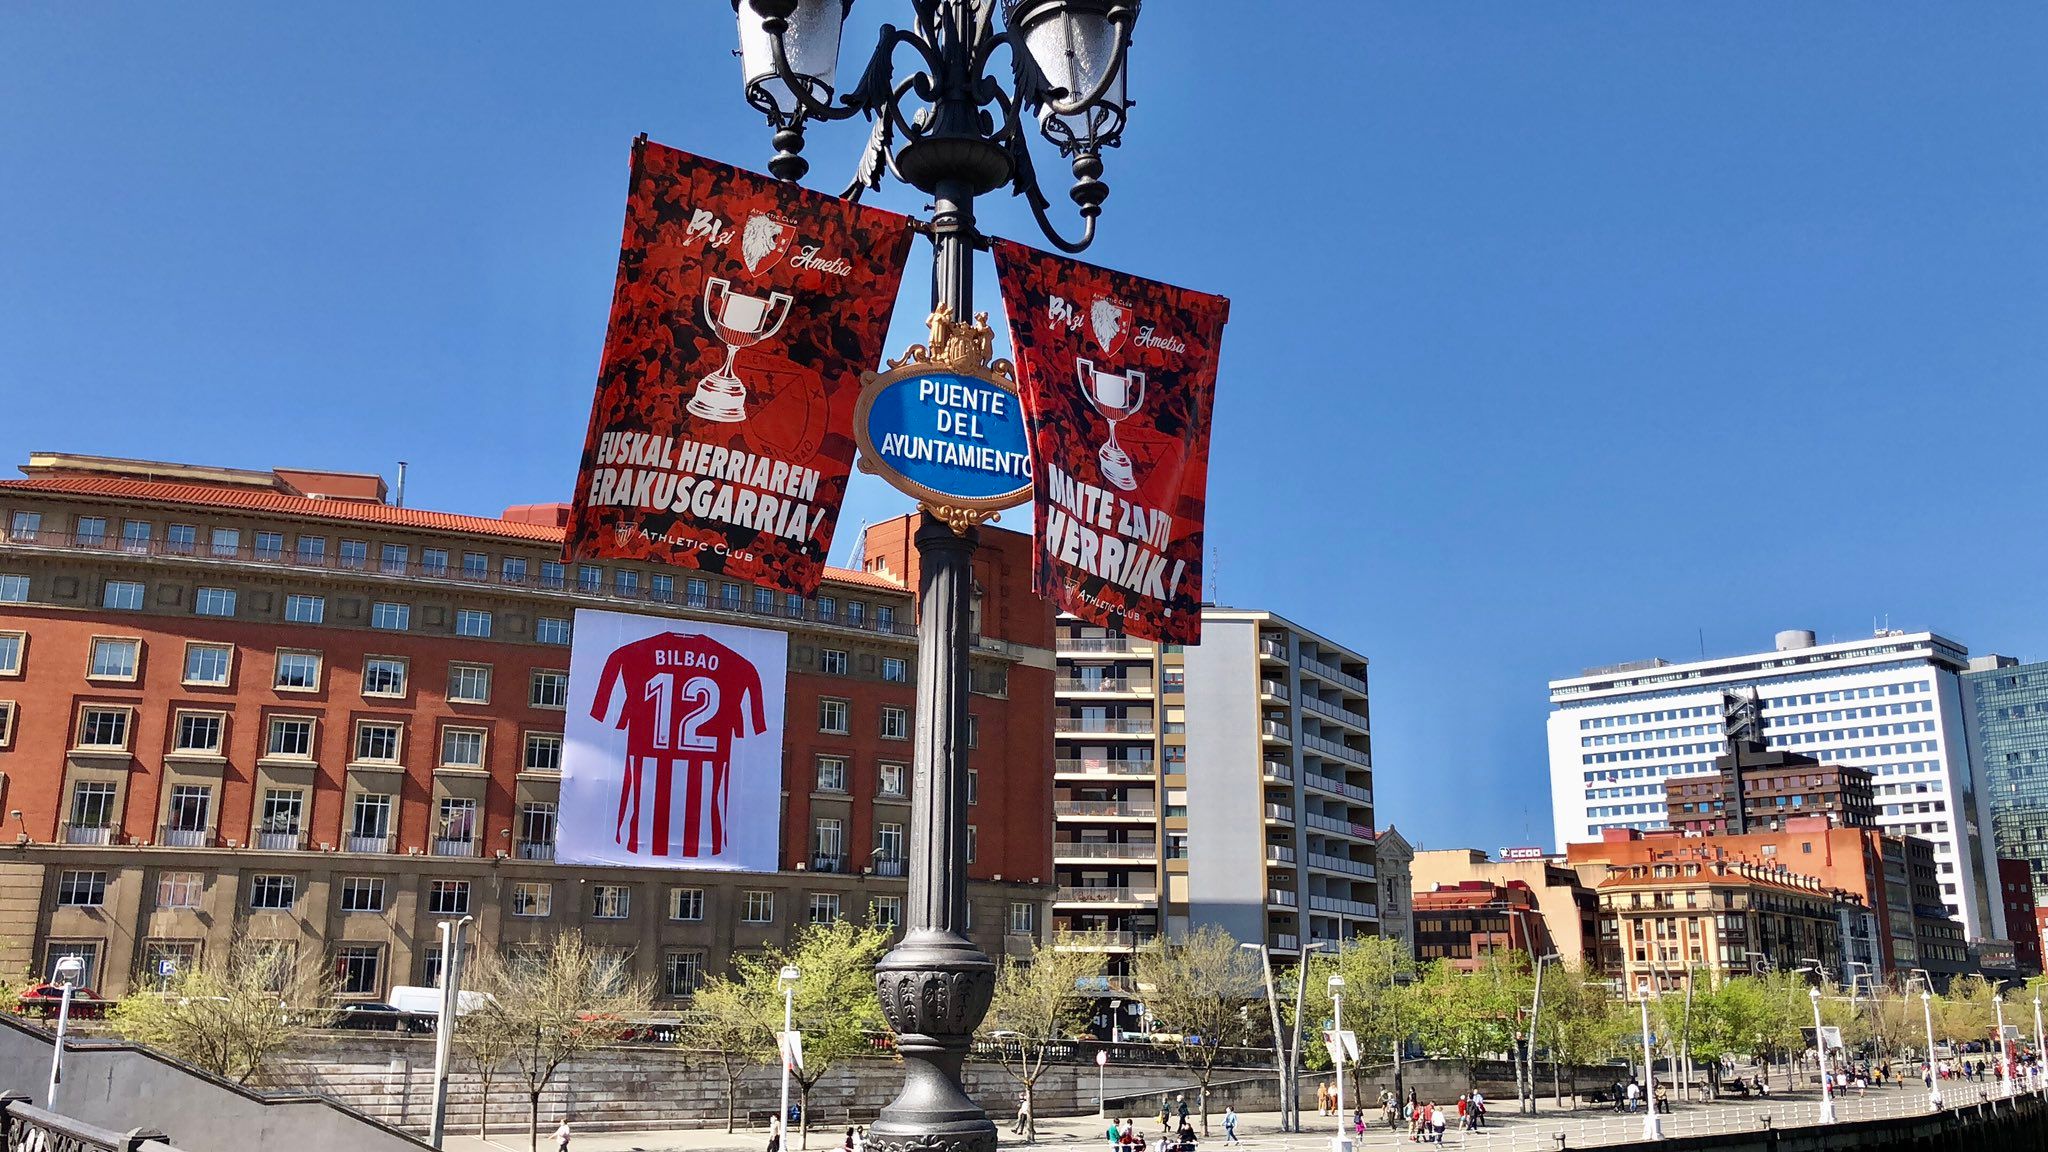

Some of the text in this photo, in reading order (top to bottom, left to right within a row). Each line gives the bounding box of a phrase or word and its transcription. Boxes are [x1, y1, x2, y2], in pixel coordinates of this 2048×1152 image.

[790, 245, 852, 277] Ametsa
[1134, 325, 1186, 354] Ametsa
[919, 379, 1005, 415] PUENTE
[937, 409, 983, 438] DEL
[596, 431, 674, 469] EUSKAL
[677, 440, 820, 502] HERRIAREN
[881, 432, 1033, 478] AYUNTAMIENTO
[588, 468, 826, 555] ERAKUSGARRIA!
[1048, 462, 1172, 553] MAITE ZAITU
[638, 529, 753, 562] ATHLETIC CLUB
[1046, 504, 1186, 618] HERRIAK!
[1077, 591, 1140, 621] ATHLETIC CLUB
[655, 649, 719, 672] BILBAO
[644, 672, 721, 752] 12
